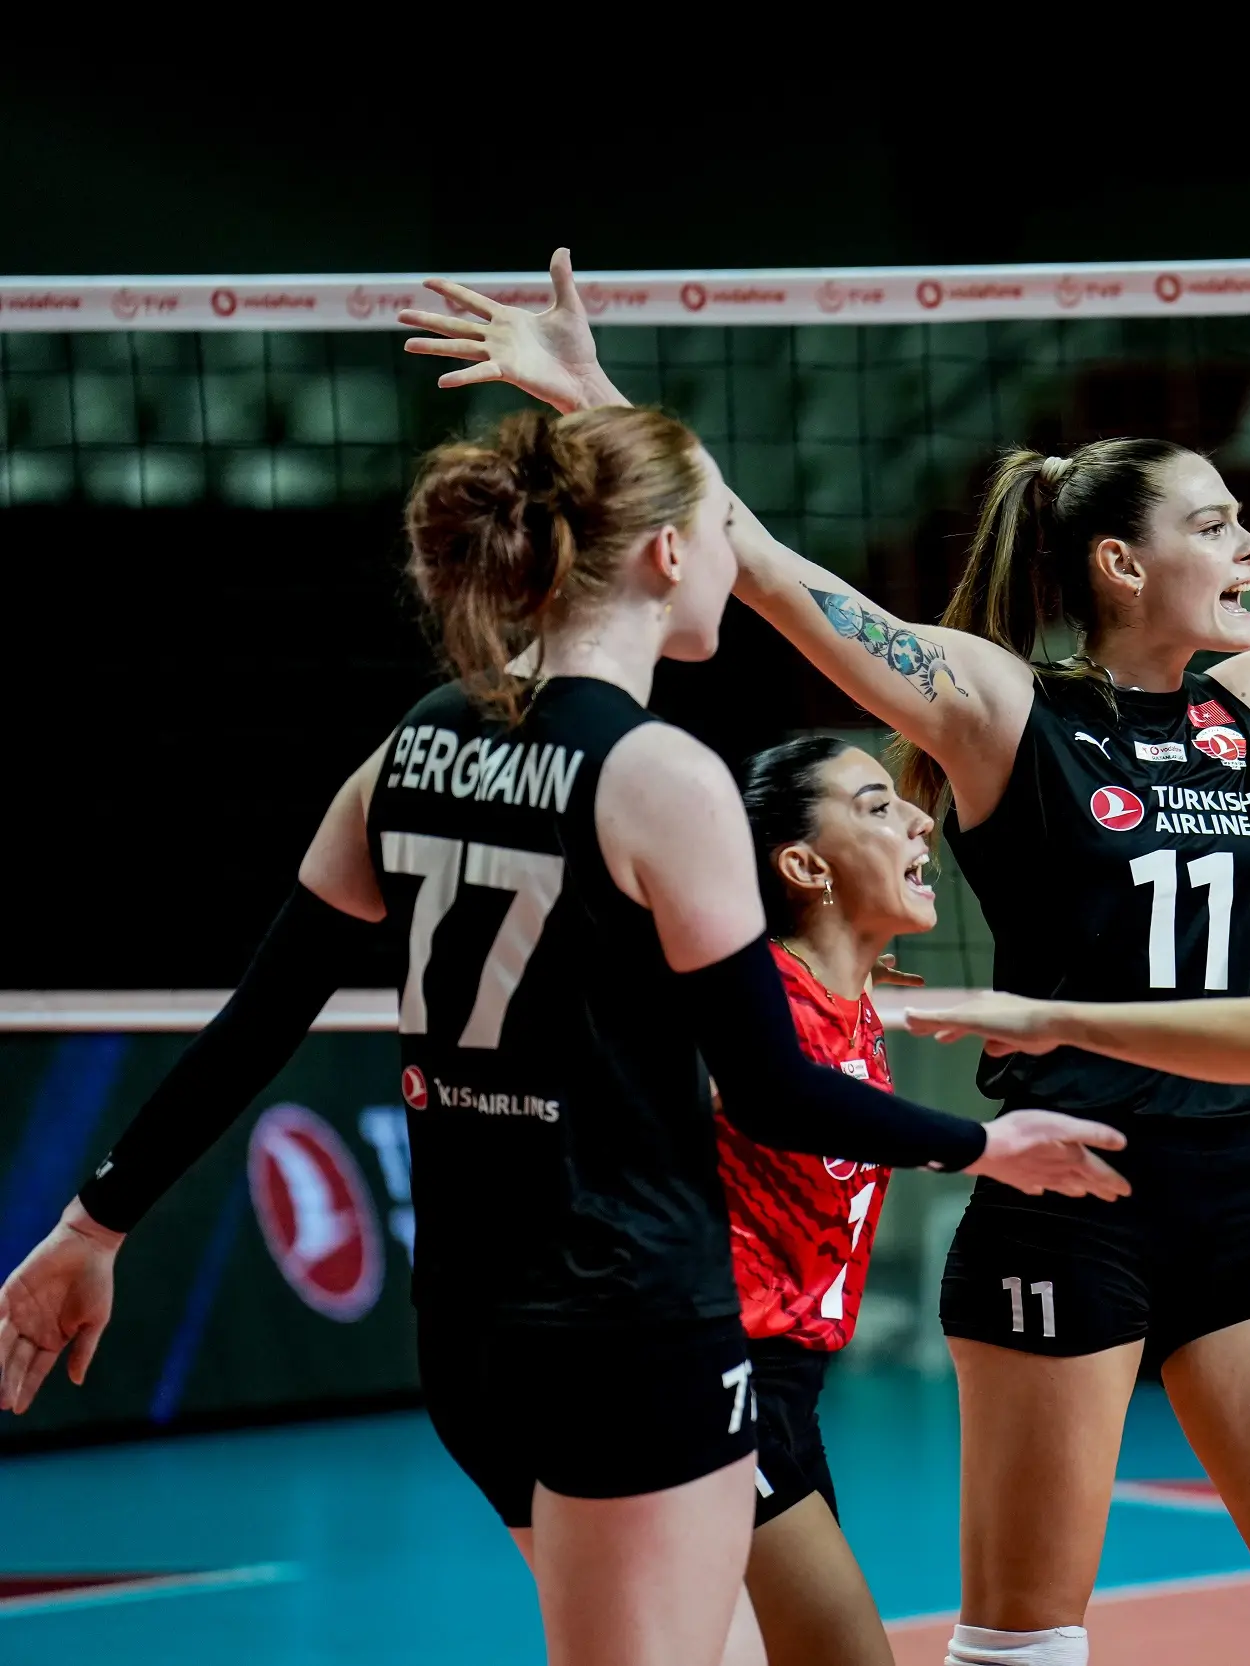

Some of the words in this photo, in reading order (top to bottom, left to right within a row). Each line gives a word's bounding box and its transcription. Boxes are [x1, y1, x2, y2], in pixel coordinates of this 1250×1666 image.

[380, 831, 564, 1049] 77
[1129, 849, 1234, 990] 11
[1002, 1276, 1056, 1338] 11
